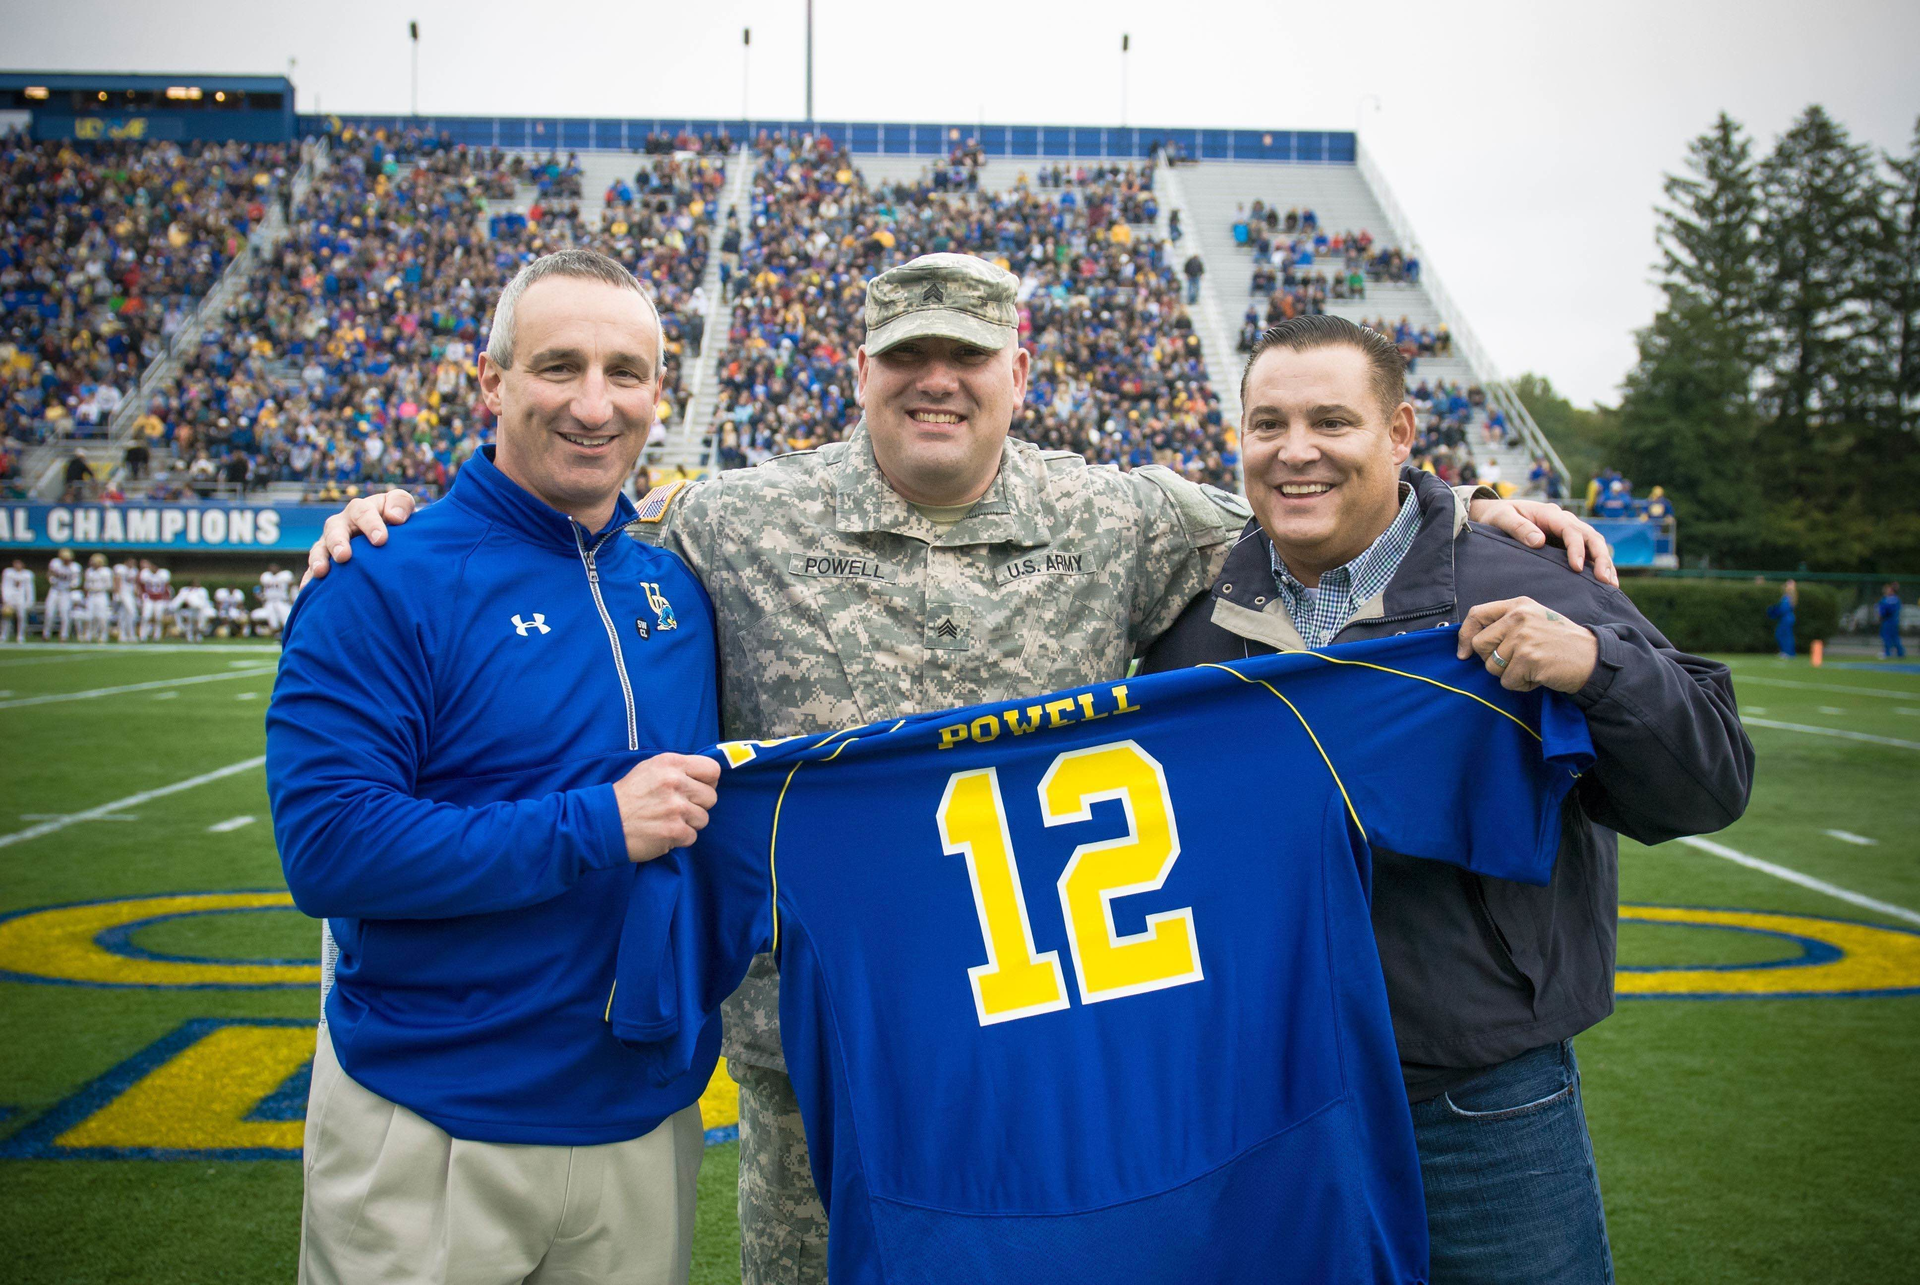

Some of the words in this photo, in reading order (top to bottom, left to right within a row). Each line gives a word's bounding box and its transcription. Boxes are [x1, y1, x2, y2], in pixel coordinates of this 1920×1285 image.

[48, 507, 280, 544] CHAMPIONS
[805, 557, 884, 579] POWELL
[1007, 559, 1041, 578] U.S.
[1046, 554, 1082, 572] ARMY
[938, 685, 1141, 750] POWELL
[936, 739, 1204, 1027] 12
